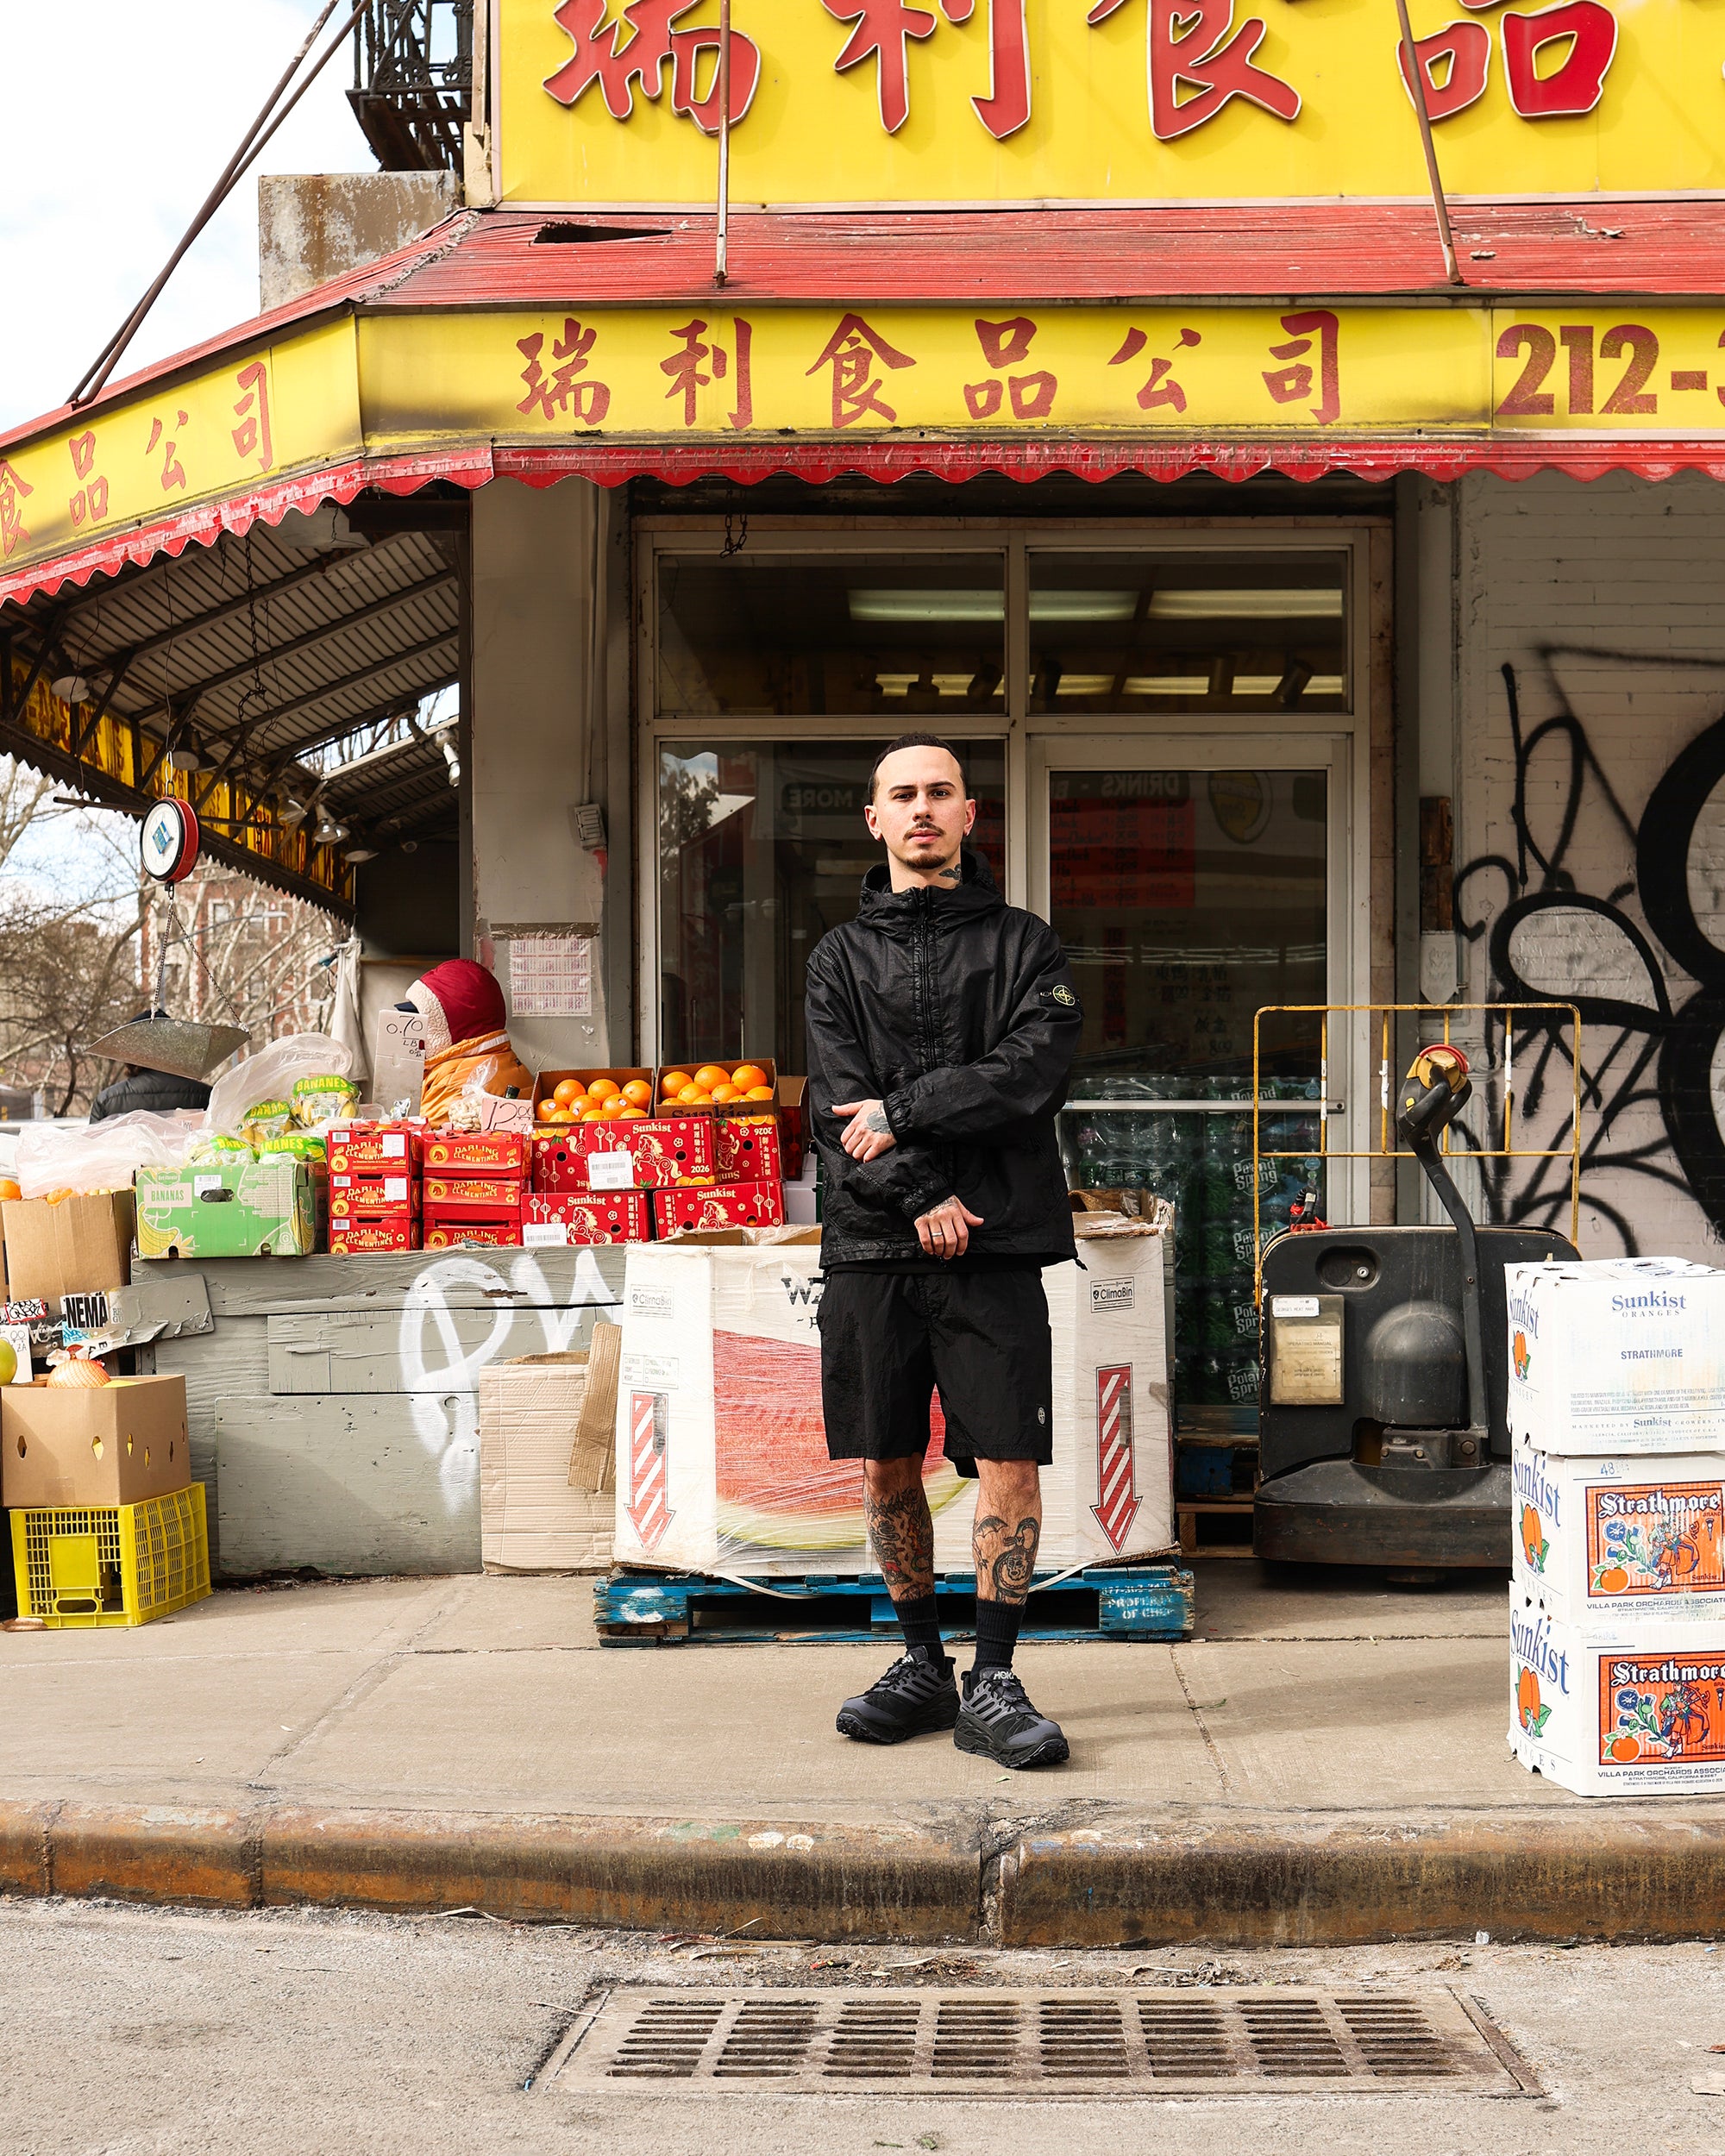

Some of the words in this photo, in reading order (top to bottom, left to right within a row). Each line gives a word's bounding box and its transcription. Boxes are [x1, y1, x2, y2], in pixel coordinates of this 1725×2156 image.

[517, 310, 1339, 429] 瑞利食品公司
[1496, 323, 1725, 416] 212-
[297, 1077, 348, 1092] BANANES
[632, 1122, 672, 1134] Sunkist
[347, 1141, 384, 1151] DARLIN
[455, 1144, 499, 1155] DARLING
[345, 1150, 393, 1161] CLEMENTIN
[691, 1164, 710, 1174] 2026
[151, 1189, 185, 1202] BANANAS
[348, 1186, 386, 1195] DARLIN
[697, 1188, 737, 1200] Sunkist
[347, 1194, 394, 1204] CLEMENTIN
[568, 1194, 606, 1206] Sunkist
[347, 1229, 392, 1240] DARLING
[345, 1238, 392, 1247] CLEMENTINES
[1101, 1287, 1132, 1300] ClimaBin
[639, 1294, 672, 1307] ClimaBin
[1612, 1290, 1687, 1312] Sunkist
[1622, 1310, 1680, 1319] ORANGES
[1621, 1349, 1684, 1360] STRATHMORE
[1634, 1417, 1672, 1428] Sunkist
[1514, 1449, 1561, 1528] Sunkist
[1598, 1488, 1721, 1520] Strathmore
[1511, 1609, 1570, 1695] Sunkist
